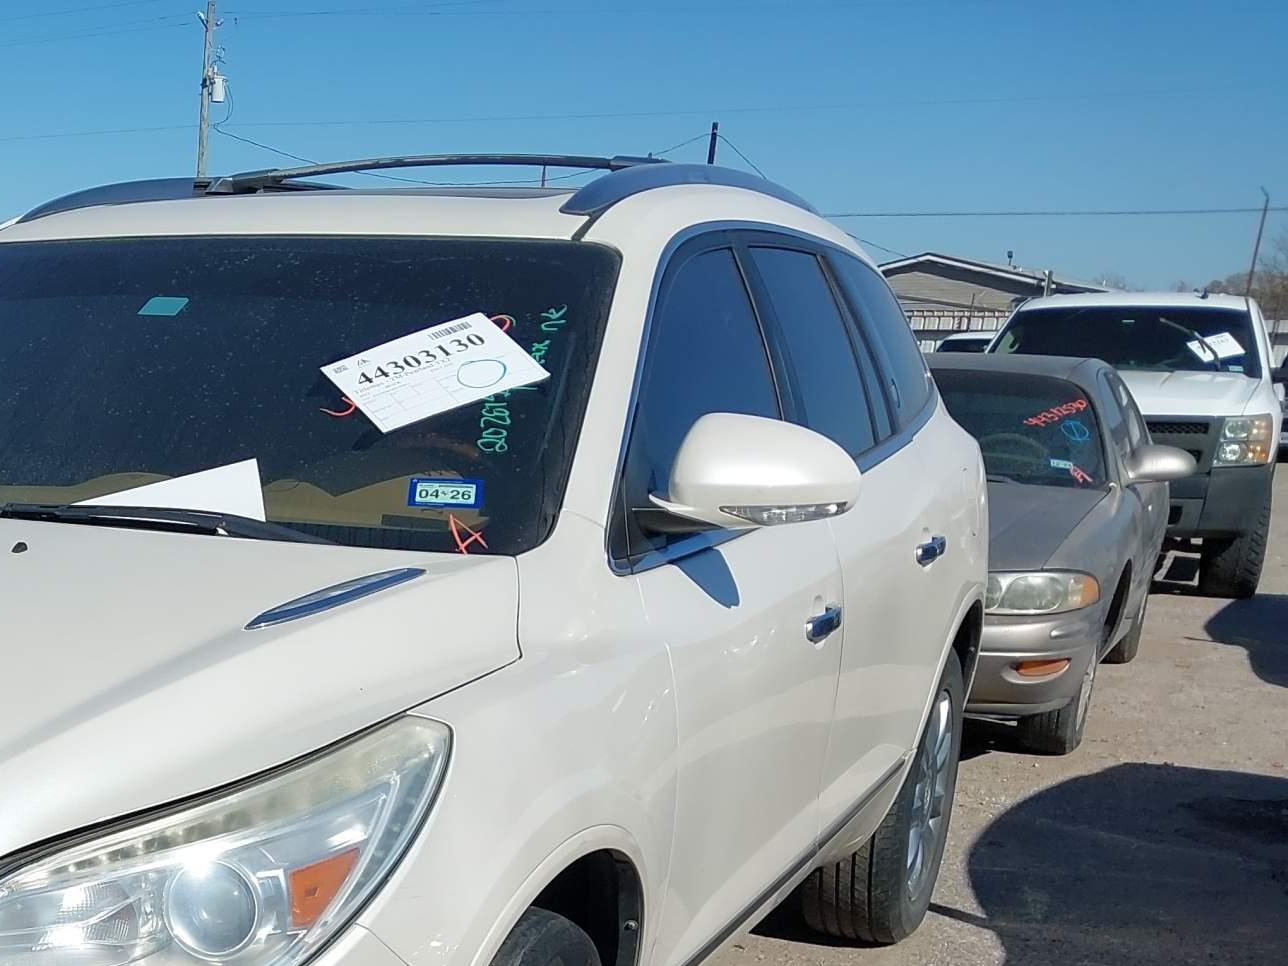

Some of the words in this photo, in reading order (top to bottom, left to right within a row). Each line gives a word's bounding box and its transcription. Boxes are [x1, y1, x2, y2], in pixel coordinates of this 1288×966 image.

[357, 333, 486, 385] 44303130
[418, 488, 440, 499] 04
[450, 489, 472, 501] 26
